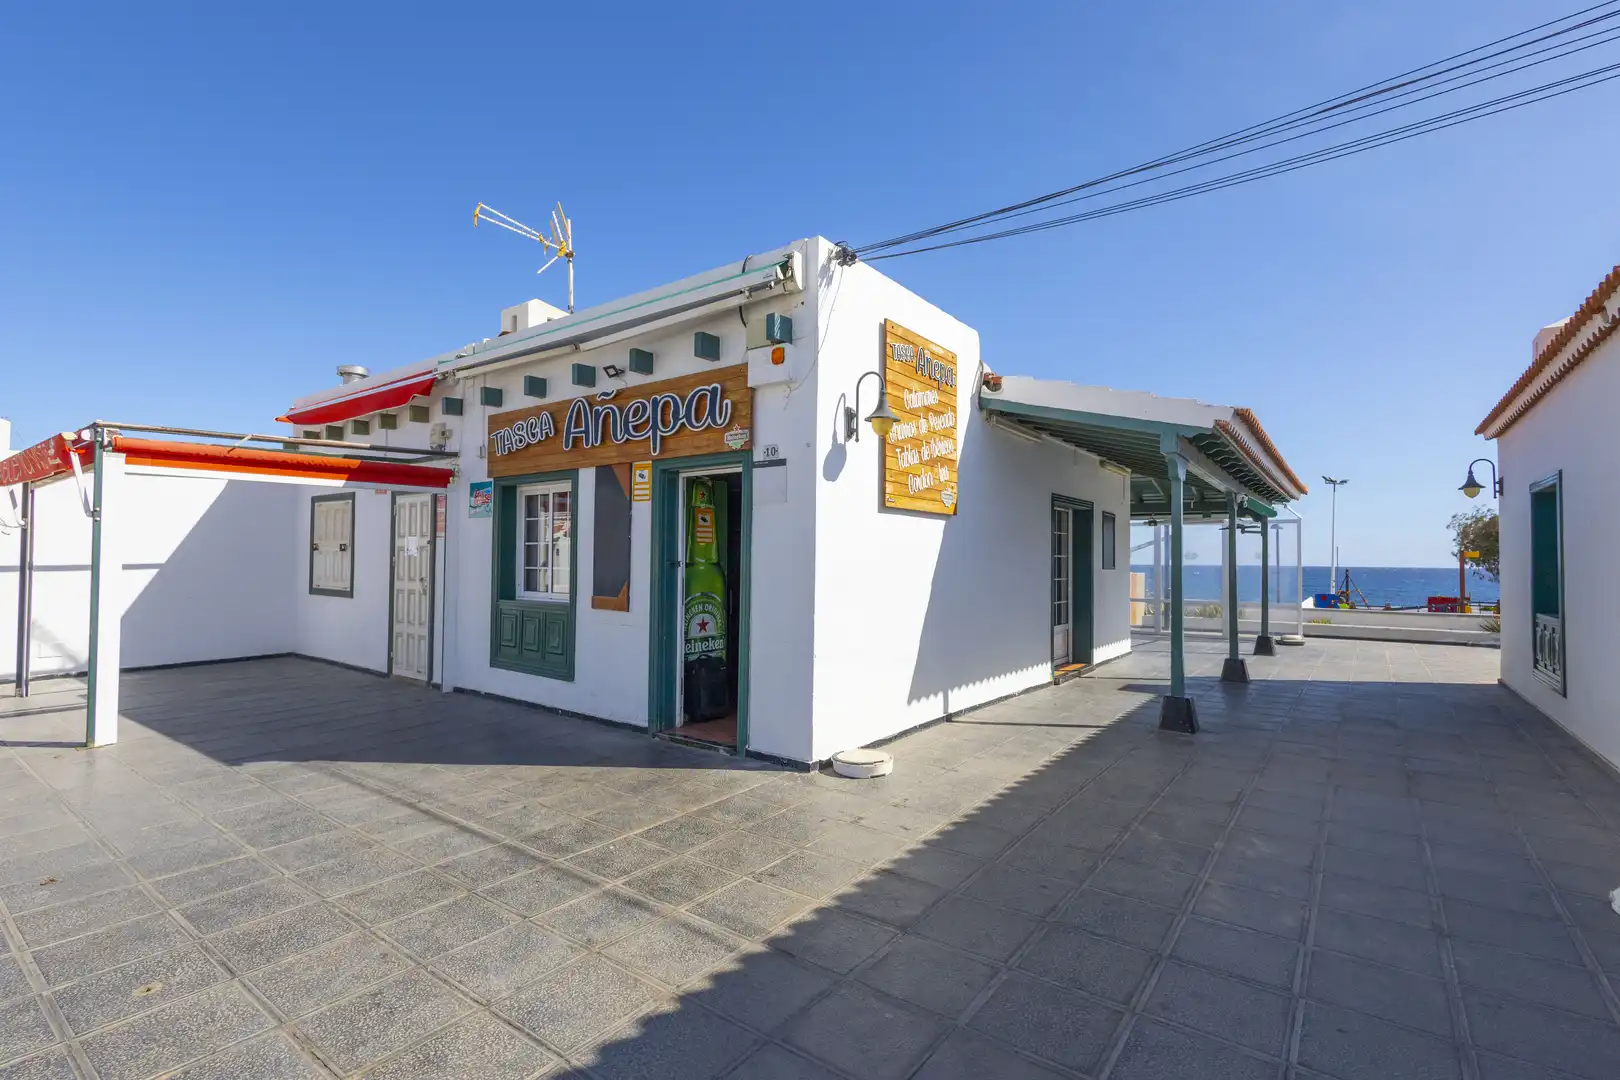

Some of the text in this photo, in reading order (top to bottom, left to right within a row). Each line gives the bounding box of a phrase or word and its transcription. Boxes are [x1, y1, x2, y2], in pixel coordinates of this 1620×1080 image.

[890, 342, 914, 362] TASCA
[490, 383, 731, 456] TASCA Añepa
[919, 413, 928, 434] de
[895, 443, 919, 470] Tablas
[921, 439, 931, 461] de
[684, 637, 725, 653] eineken
